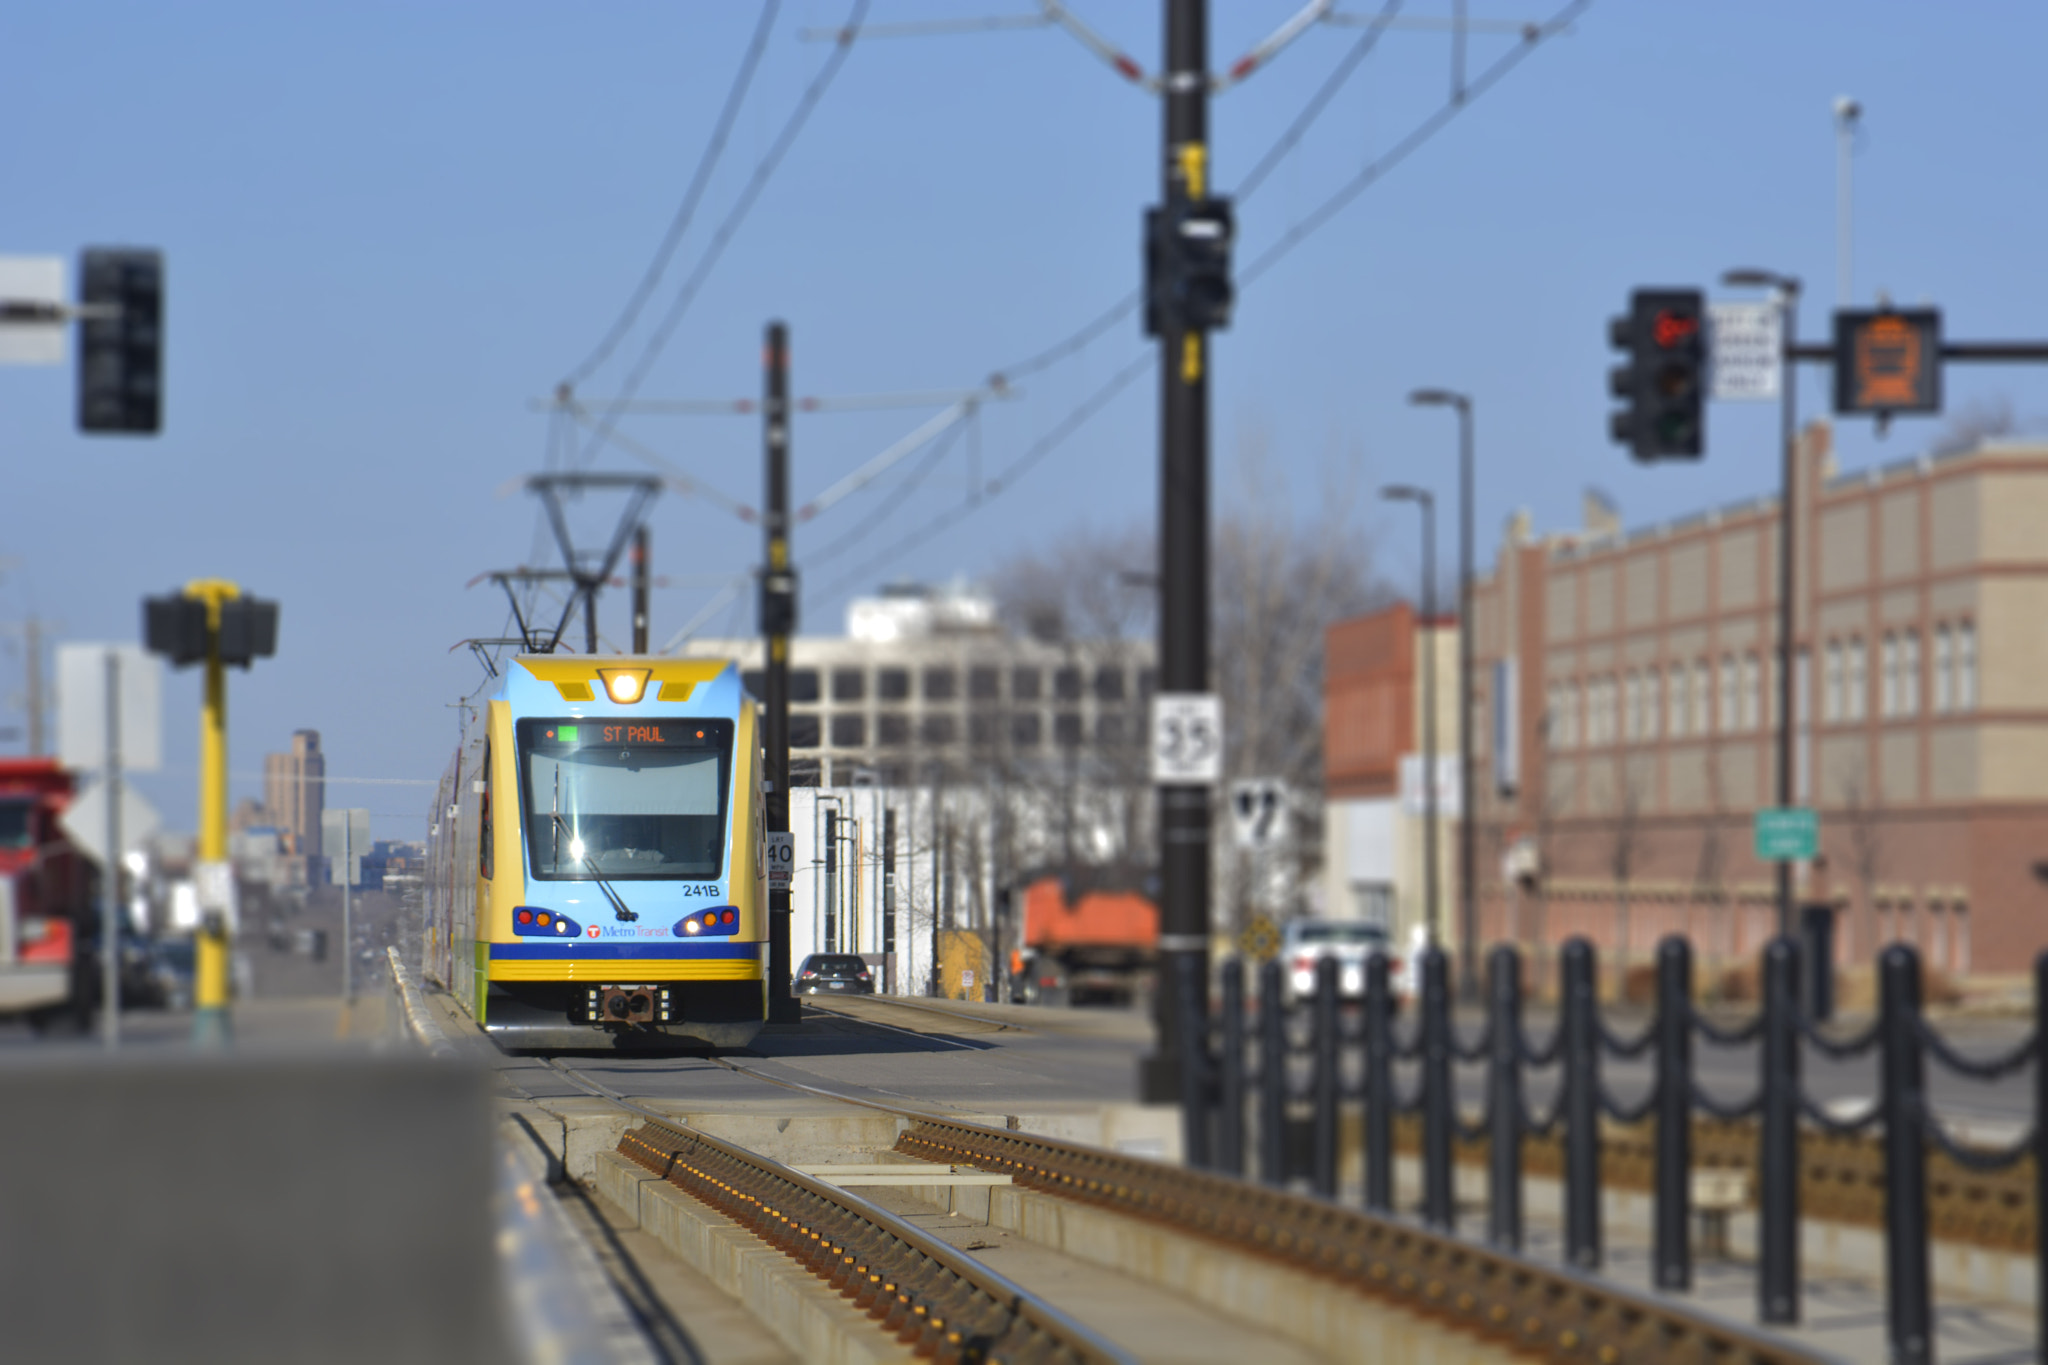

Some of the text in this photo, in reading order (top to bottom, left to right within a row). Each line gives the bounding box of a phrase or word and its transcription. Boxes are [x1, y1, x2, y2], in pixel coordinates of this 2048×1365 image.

[603, 726, 665, 742] ST PAUL
[768, 844, 792, 863] 40
[683, 885, 720, 897] 241B
